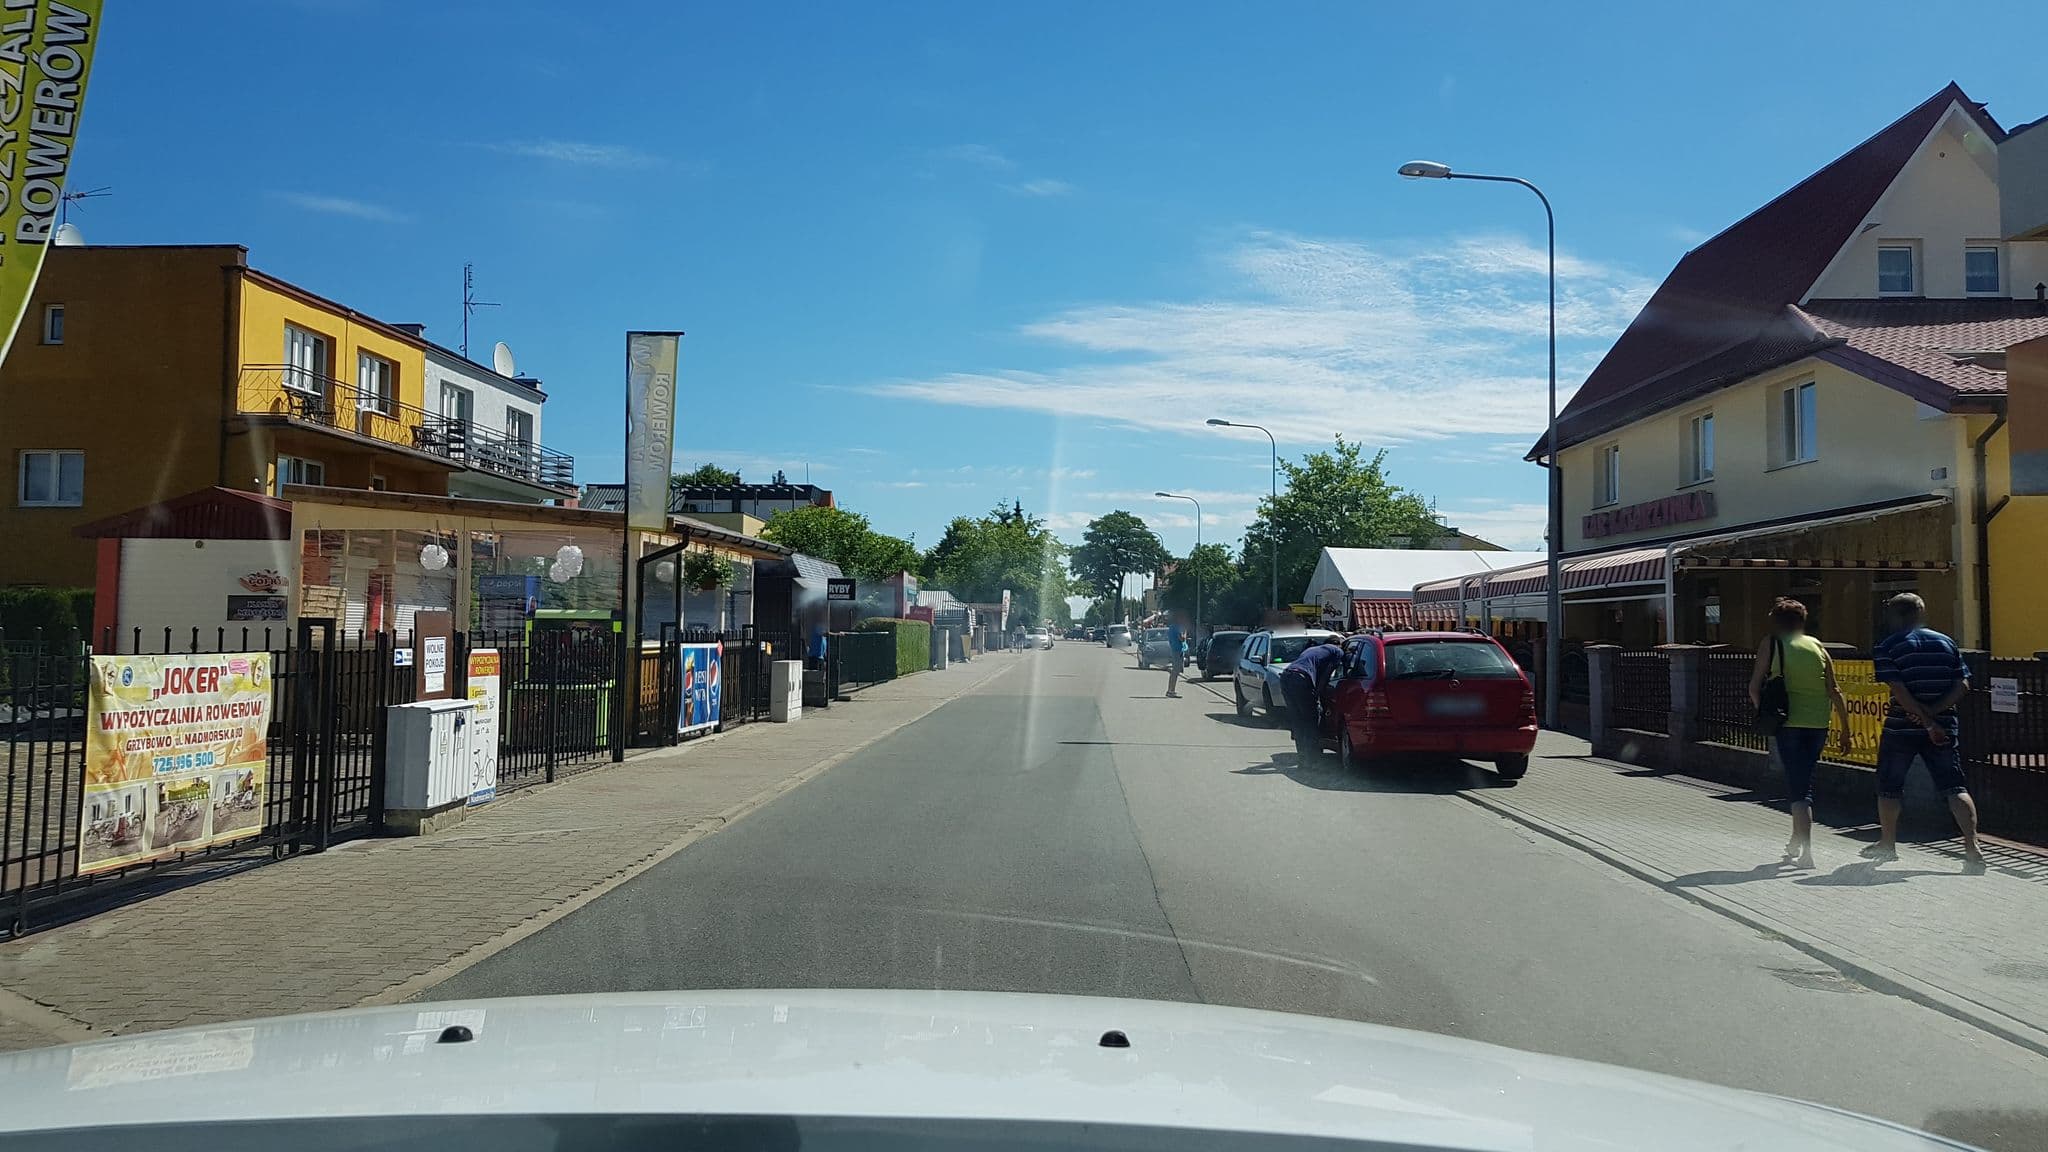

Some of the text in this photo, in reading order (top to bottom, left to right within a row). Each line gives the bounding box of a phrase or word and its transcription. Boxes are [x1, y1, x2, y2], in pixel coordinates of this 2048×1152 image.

[16, 2, 89, 243] ROWERÓW
[829, 584, 850, 593] RYBY
[426, 644, 444, 654] WOLNE
[426, 658, 444, 668] POKOJE
[100, 700, 262, 730] WYPOŻYCZALNIA ROWERÓW
[1846, 695, 1890, 721] pokoje
[126, 735, 172, 751] GRZYBOWO
[184, 729, 235, 745] NADMORSKA
[153, 756, 174, 772] 725
[195, 751, 214, 768] 500
